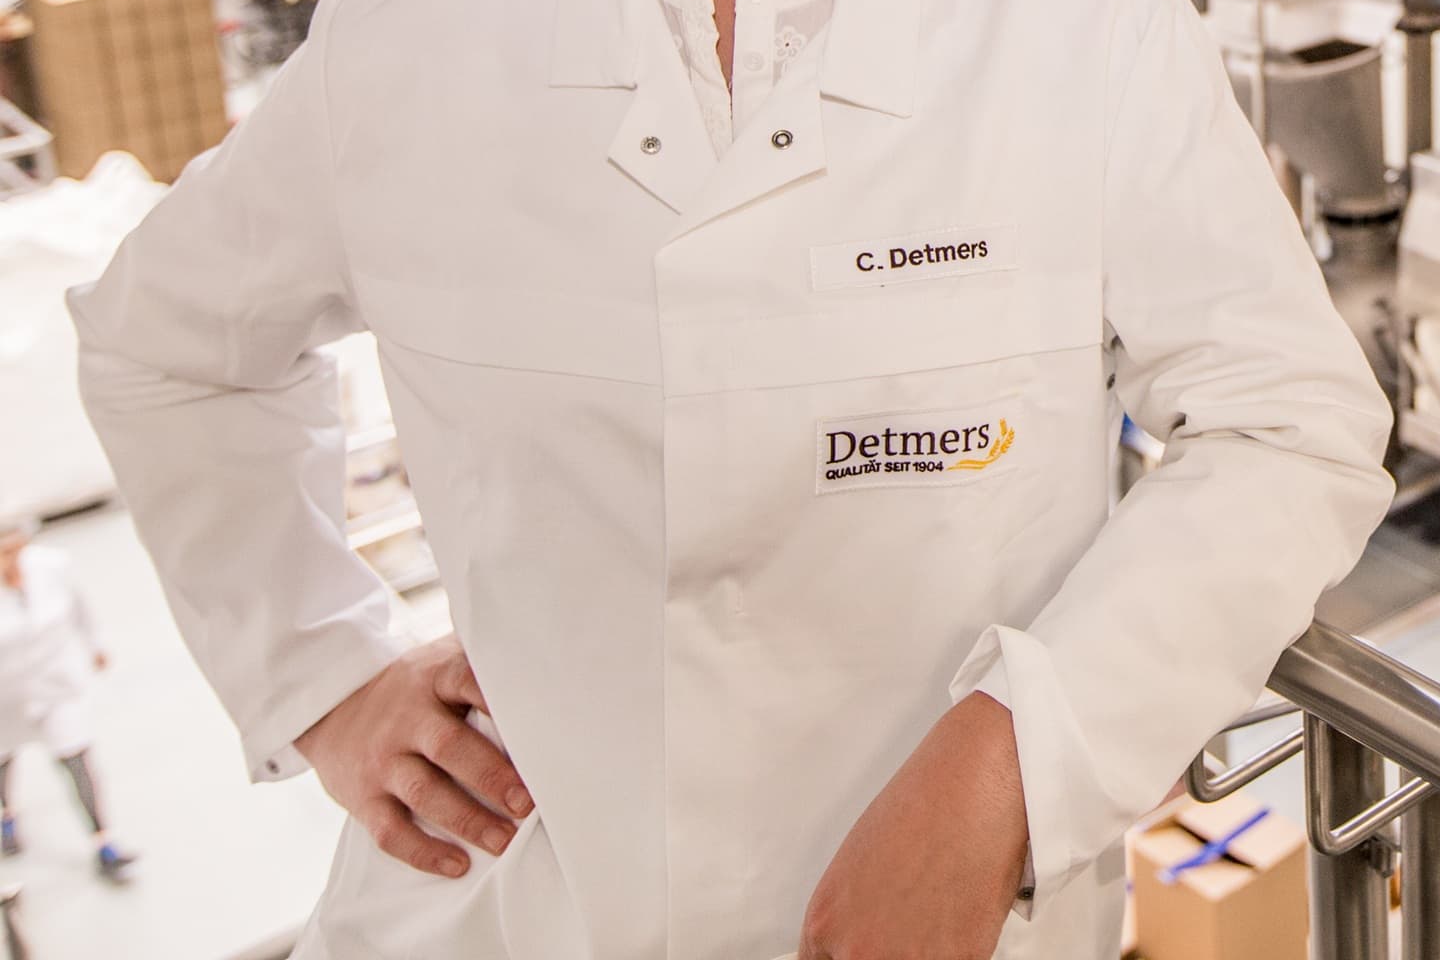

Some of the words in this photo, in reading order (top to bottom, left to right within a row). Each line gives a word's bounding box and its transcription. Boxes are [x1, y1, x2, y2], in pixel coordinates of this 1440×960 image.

[856, 252, 884, 272] C.
[889, 240, 988, 269] Detmers
[826, 423, 989, 465] Detmers
[825, 459, 882, 480] QUALITÄT
[884, 461, 911, 473] SEIT
[912, 460, 945, 473] 1904
